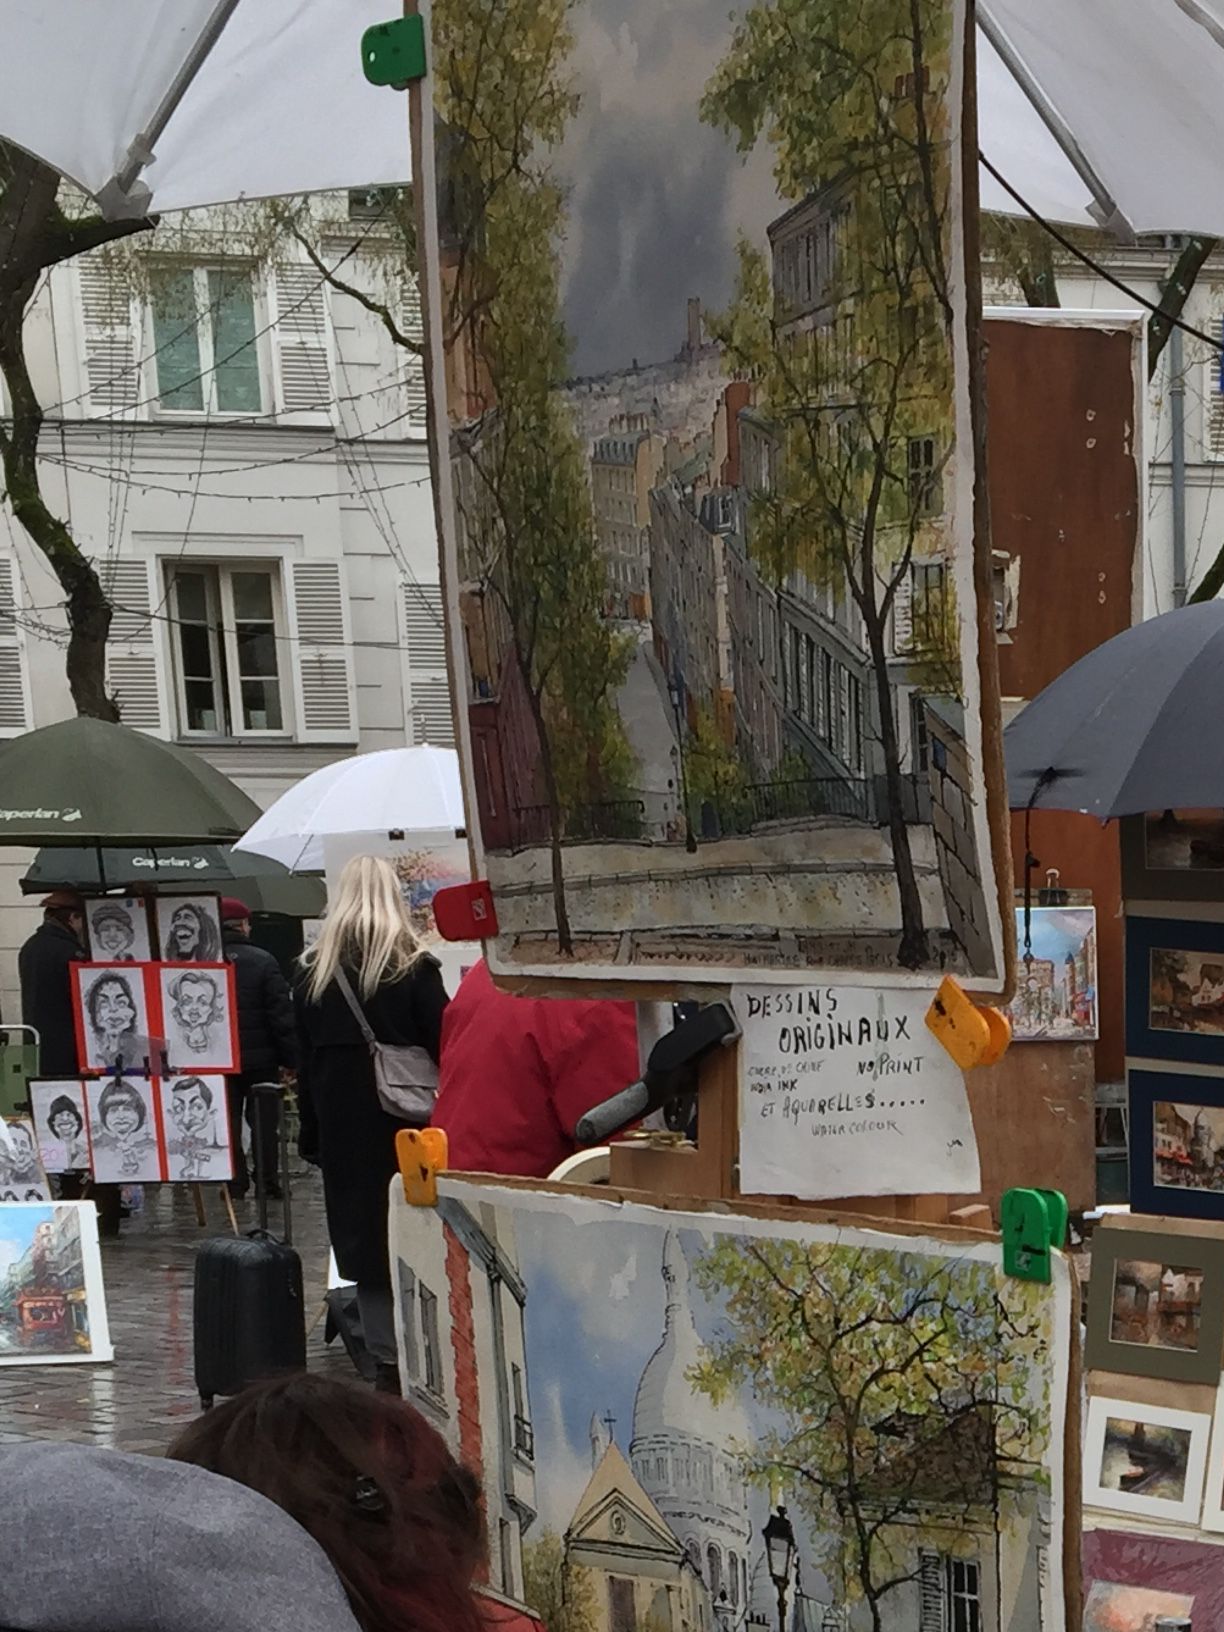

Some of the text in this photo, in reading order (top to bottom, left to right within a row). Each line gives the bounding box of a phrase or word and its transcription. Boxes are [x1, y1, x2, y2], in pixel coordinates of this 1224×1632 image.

[0, 808, 60, 821] aperlan
[747, 988, 838, 1018] DESSINS
[778, 1016, 911, 1055] ORIGINAUX
[879, 1052, 924, 1075] PRINT
[778, 1078, 798, 1092] INK
[760, 1101, 776, 1118] ET
